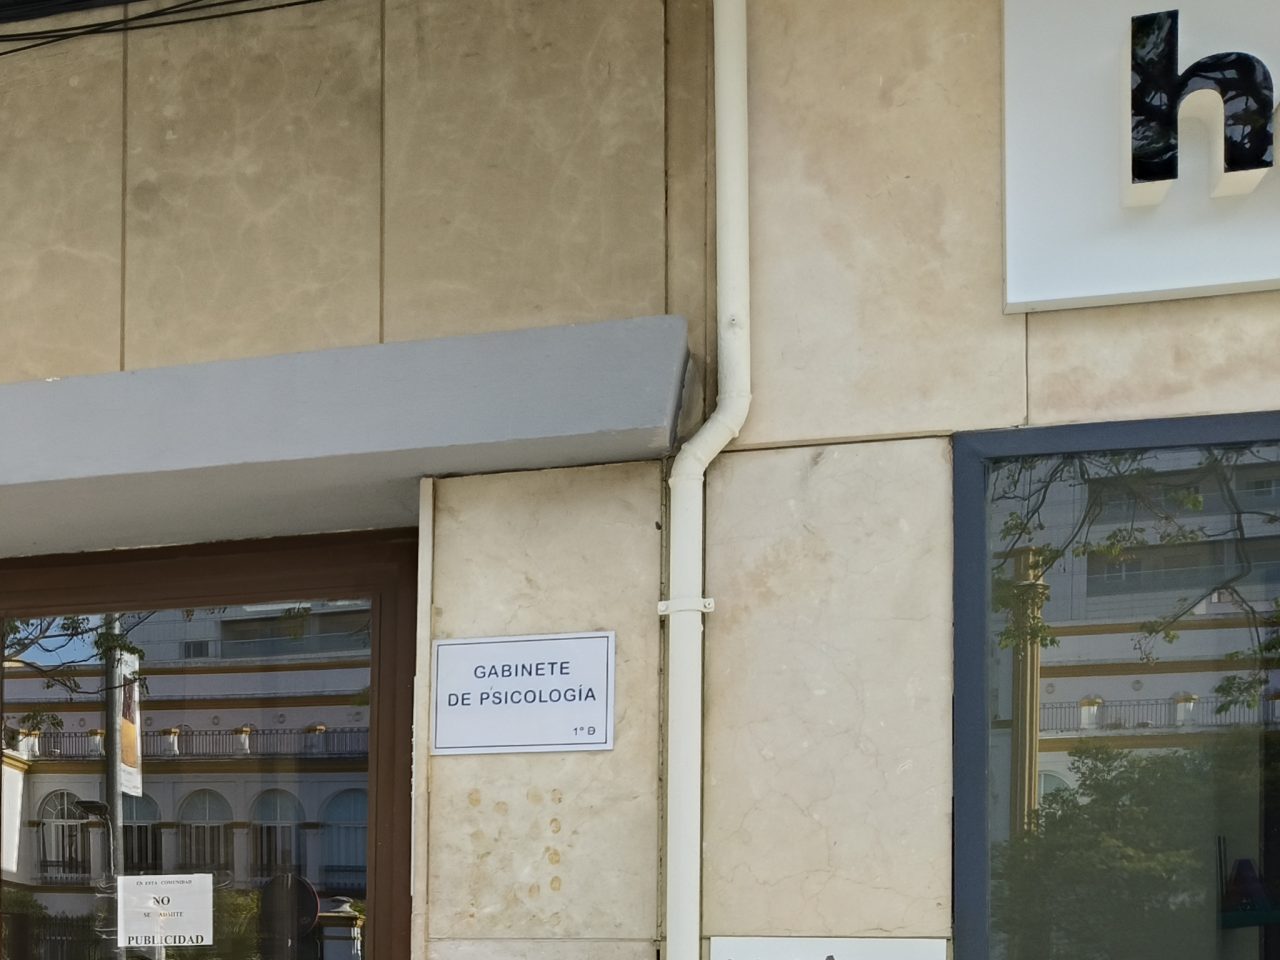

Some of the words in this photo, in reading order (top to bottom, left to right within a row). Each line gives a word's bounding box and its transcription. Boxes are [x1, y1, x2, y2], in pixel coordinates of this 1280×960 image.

[474, 661, 571, 679] GABINETE
[448, 692, 471, 707] DE
[480, 684, 596, 706] PSICOLOGÍA
[153, 896, 170, 905] NO
[127, 935, 204, 945] PUBLICIDAD
